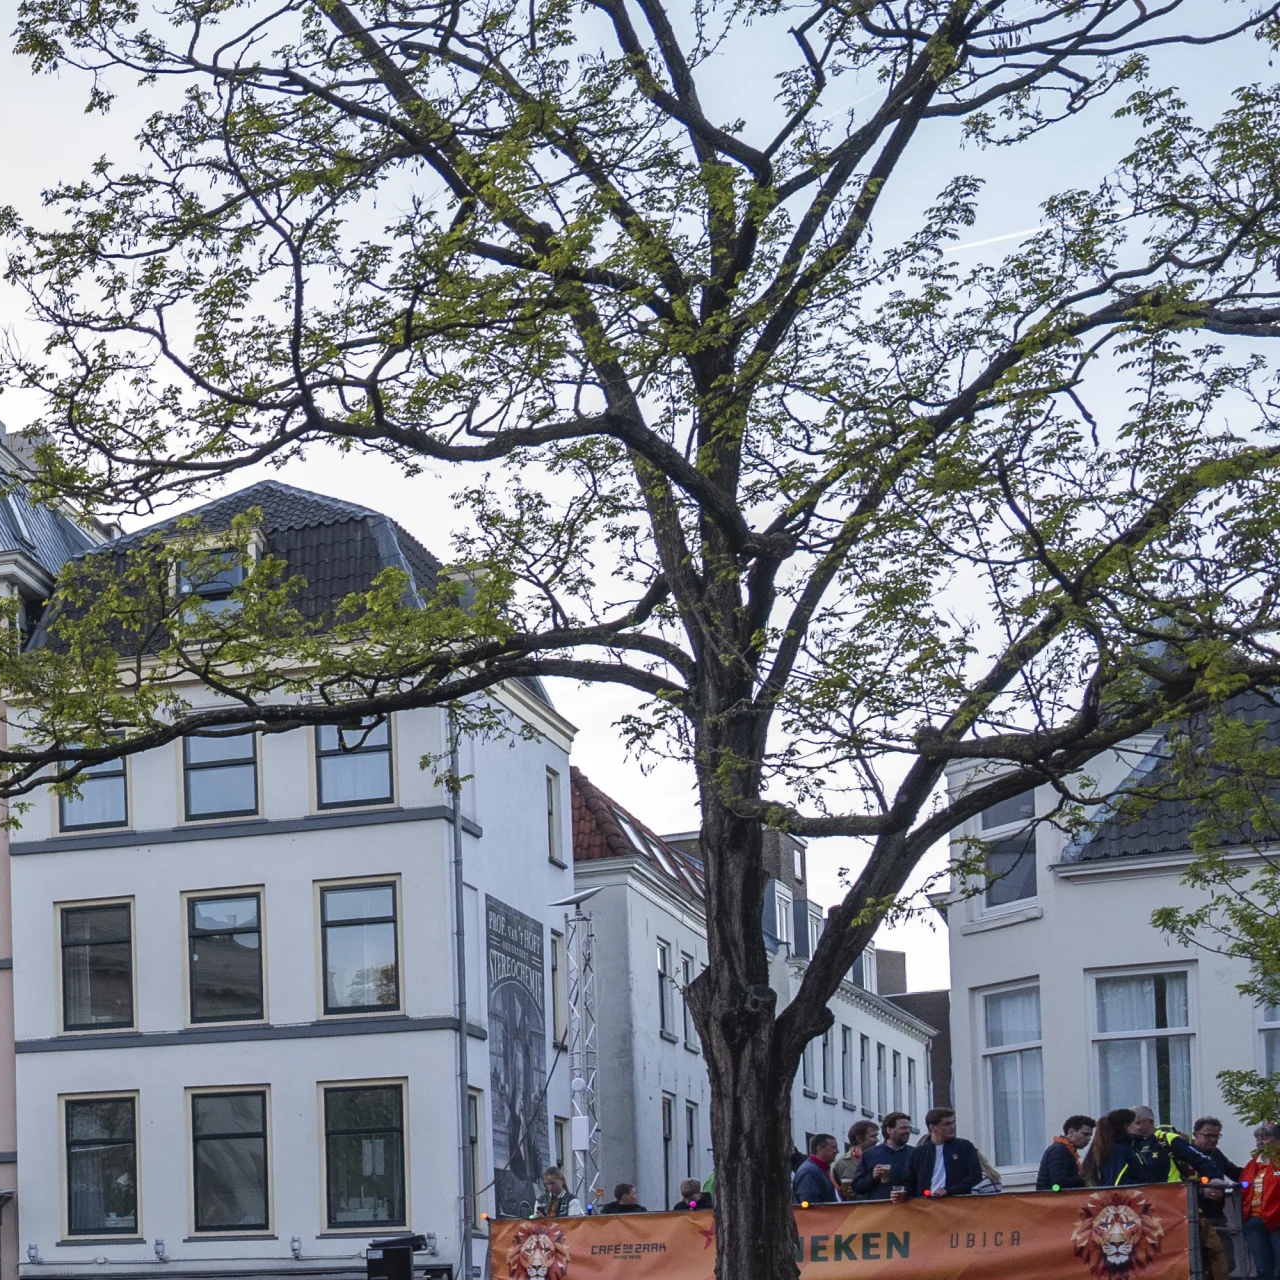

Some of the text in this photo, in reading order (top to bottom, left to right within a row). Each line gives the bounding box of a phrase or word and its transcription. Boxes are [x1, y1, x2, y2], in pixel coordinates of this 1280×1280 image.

[488, 910, 507, 937] PROF.
[524, 929, 542, 955] HOFF
[489, 948, 543, 1006] STEREOCHEMIE
[591, 1242, 621, 1255] CAFÉ
[794, 1230, 1021, 1263] EKEN UBICA
